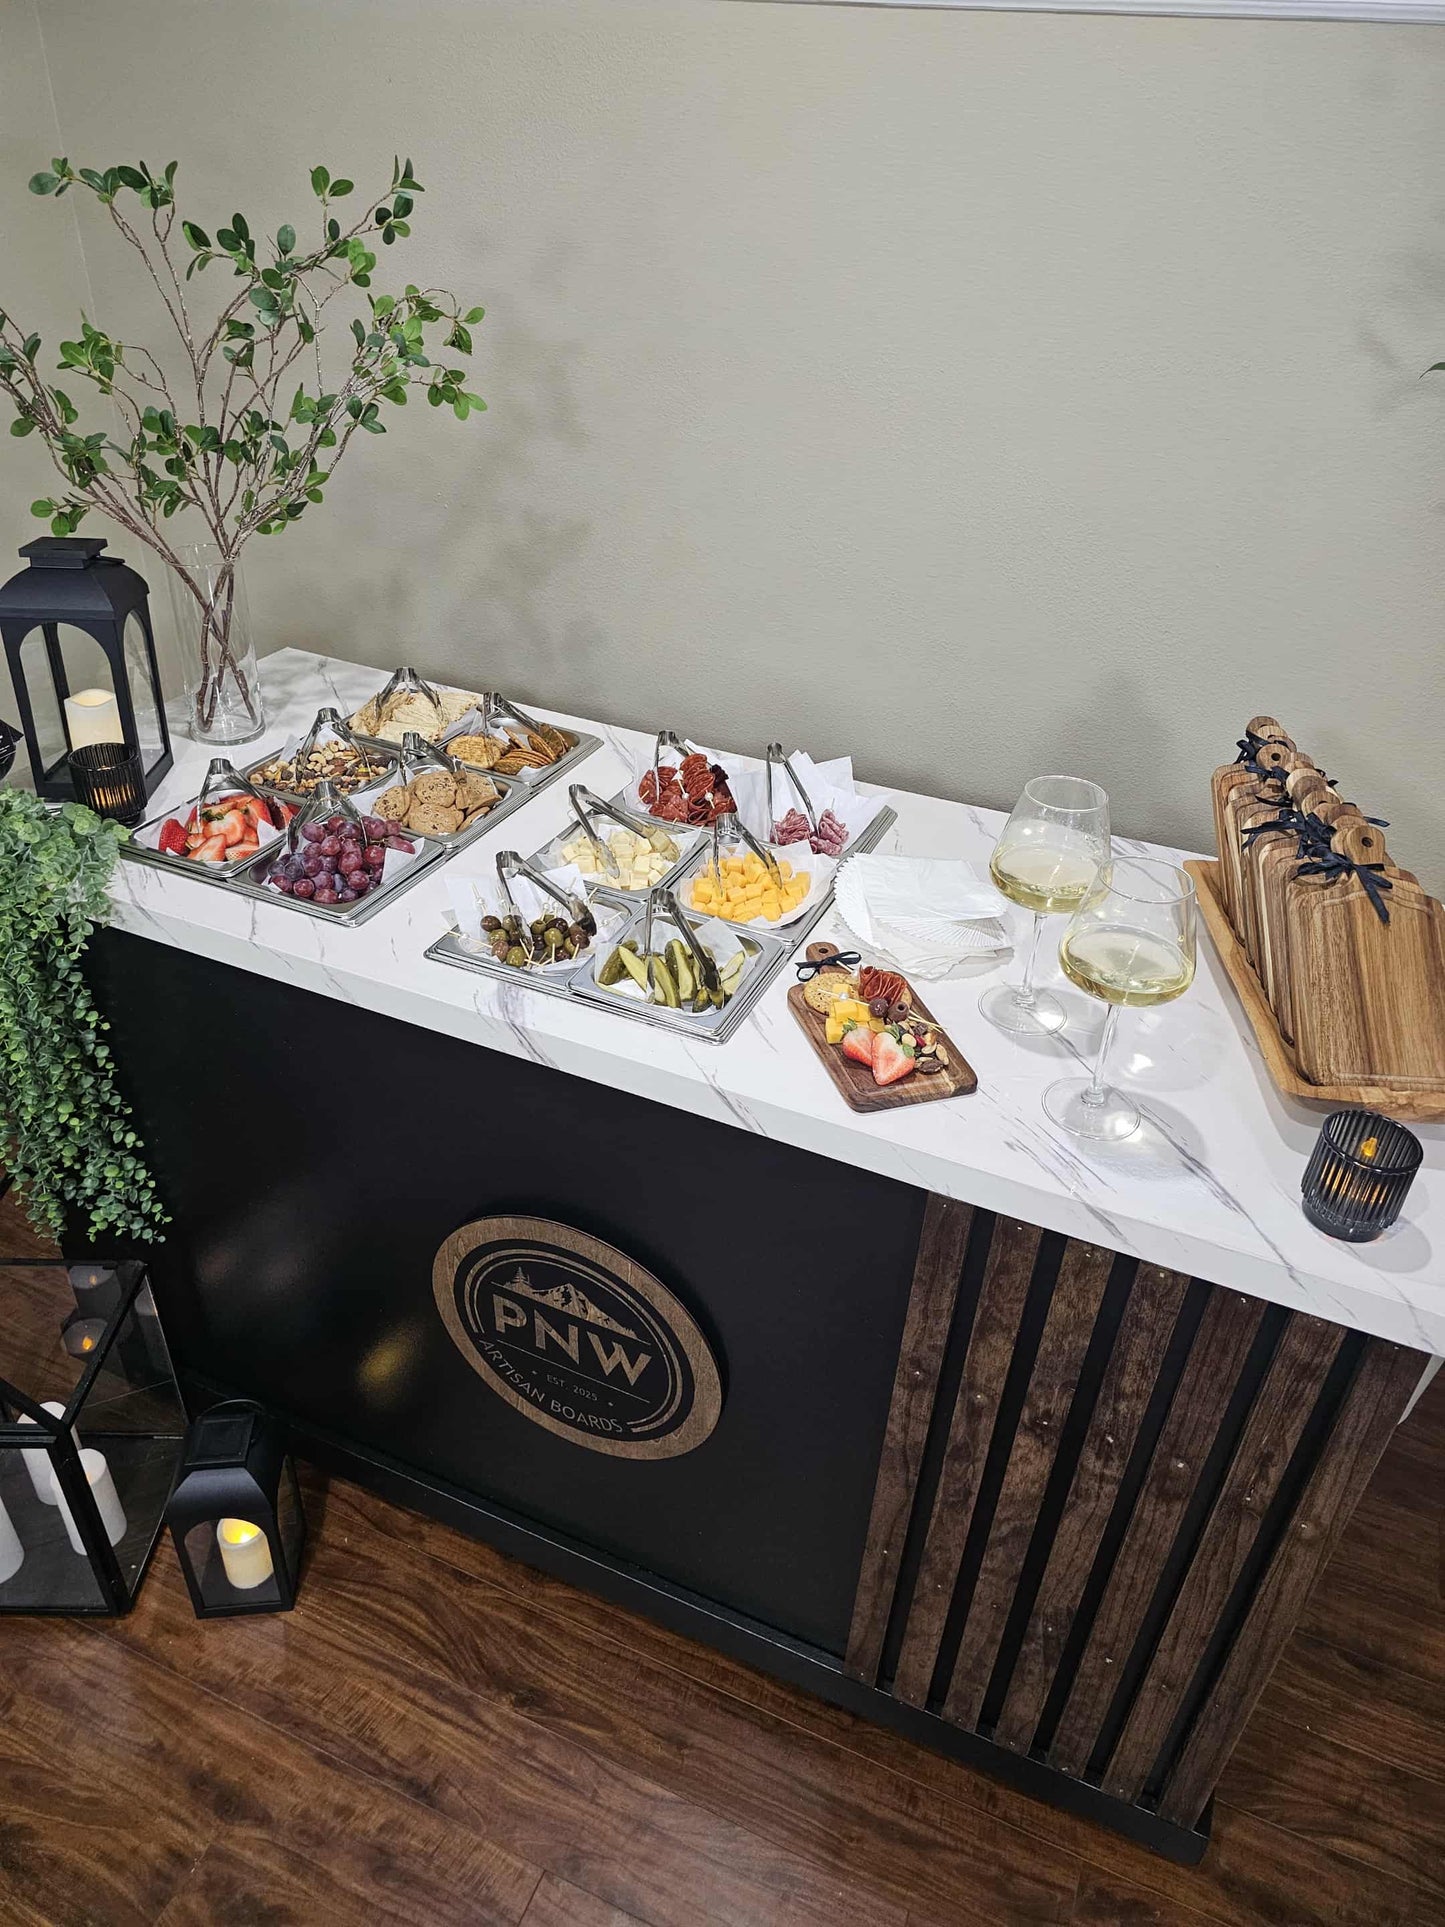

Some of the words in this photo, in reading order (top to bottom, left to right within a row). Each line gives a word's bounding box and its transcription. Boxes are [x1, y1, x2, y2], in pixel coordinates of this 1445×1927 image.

[492, 1295, 652, 1386] PNW
[479, 1340, 545, 1403] ARTISAN
[550, 1400, 623, 1433] BOARDS
[547, 1375, 569, 1390] EST.
[573, 1386, 598, 1401] 2025
